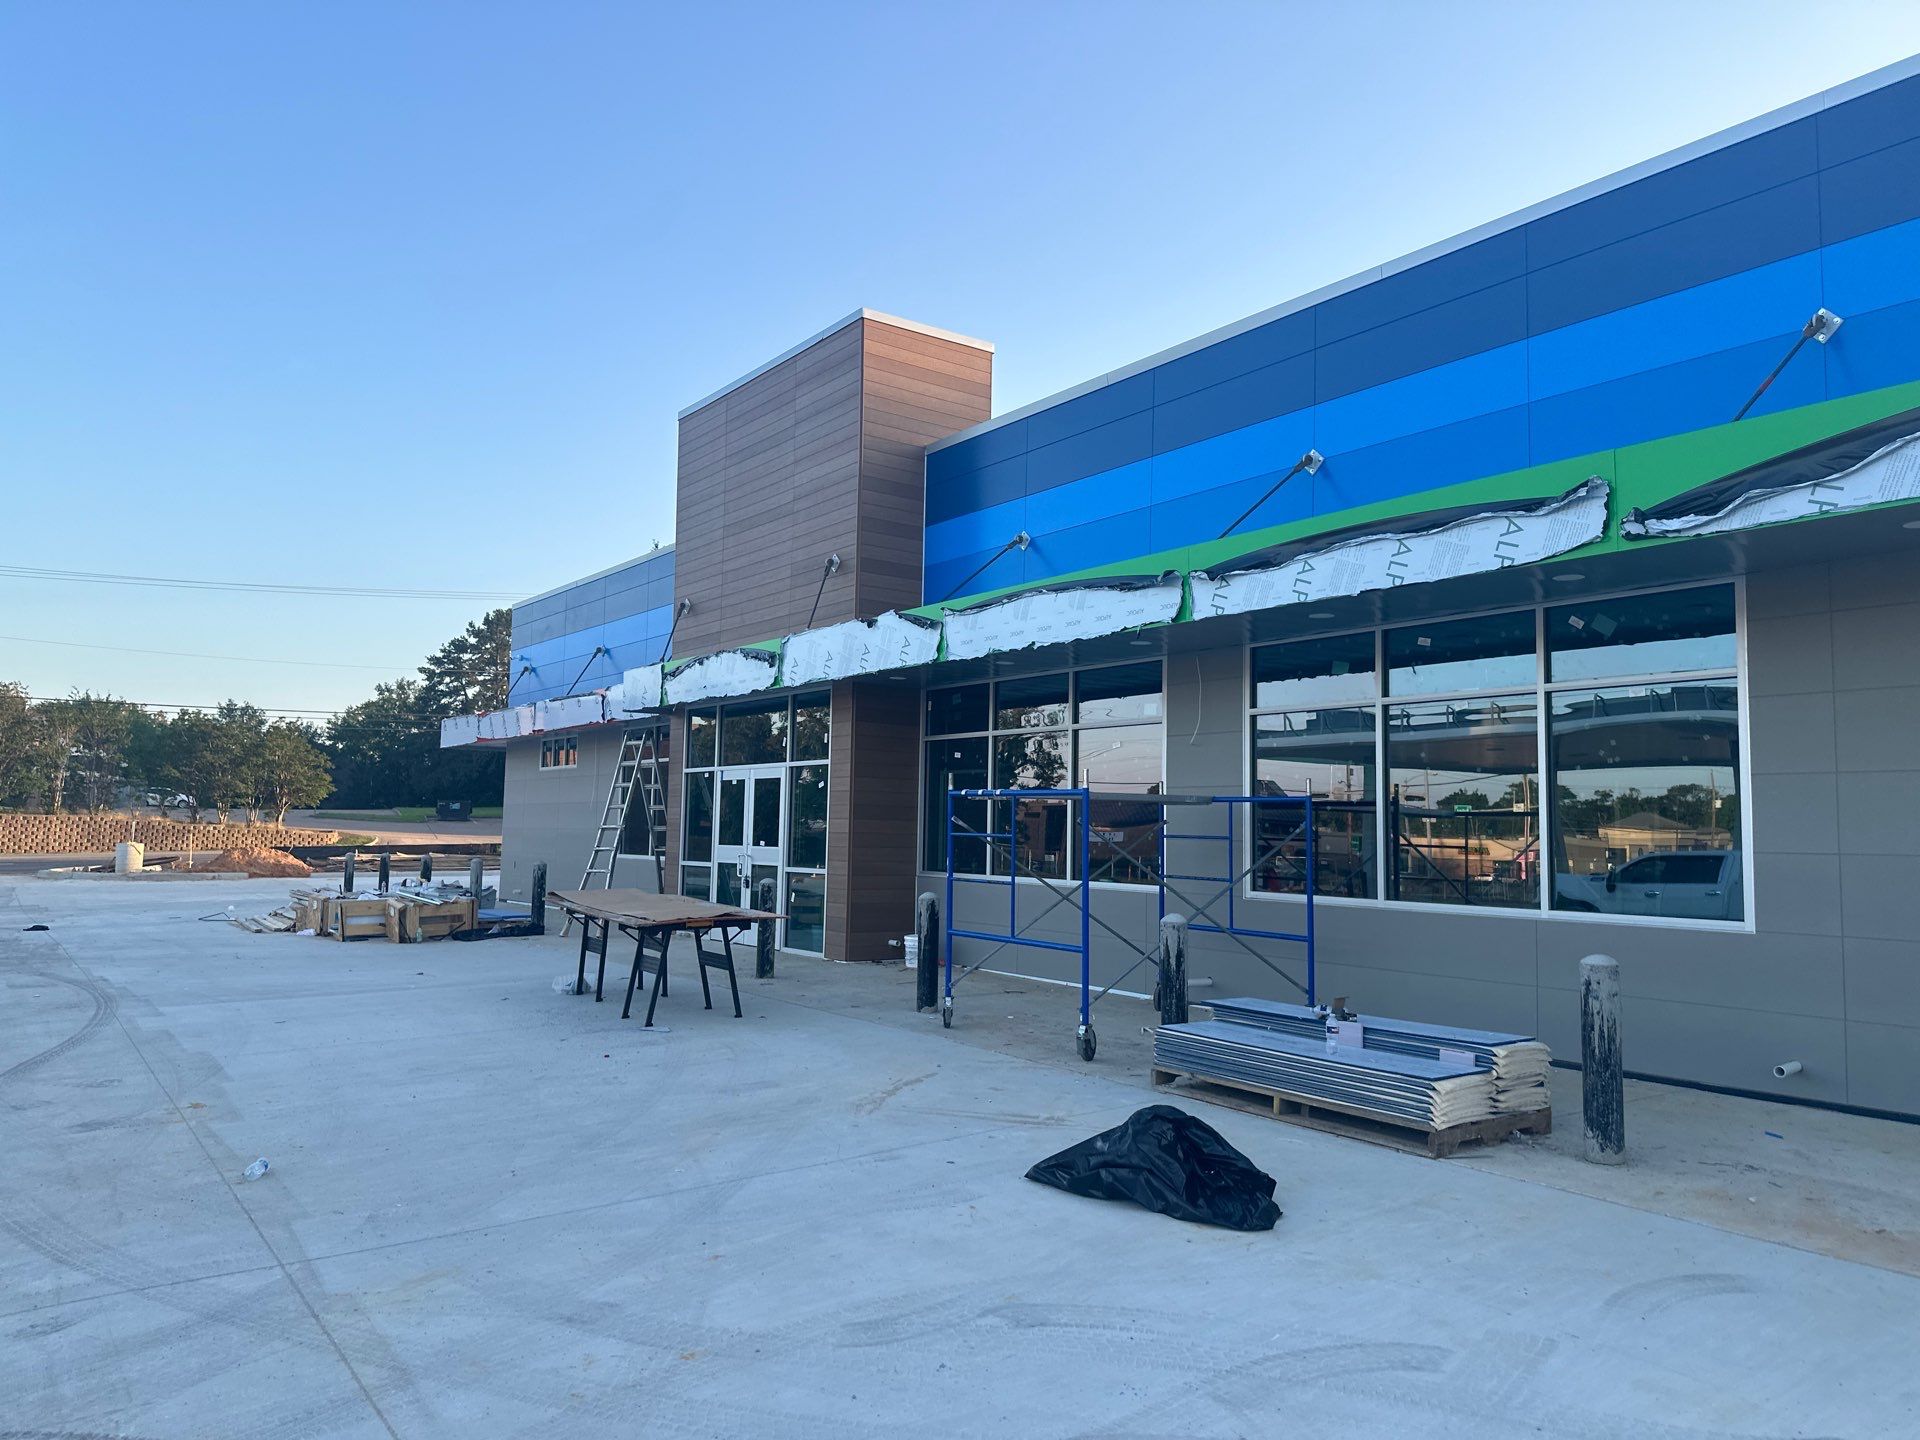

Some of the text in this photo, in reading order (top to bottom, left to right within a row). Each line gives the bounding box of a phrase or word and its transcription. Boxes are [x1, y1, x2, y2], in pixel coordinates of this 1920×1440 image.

[1292, 560, 1316, 601] ALP
[1386, 539, 1413, 586] ALP
[1211, 575, 1231, 616] ALP
